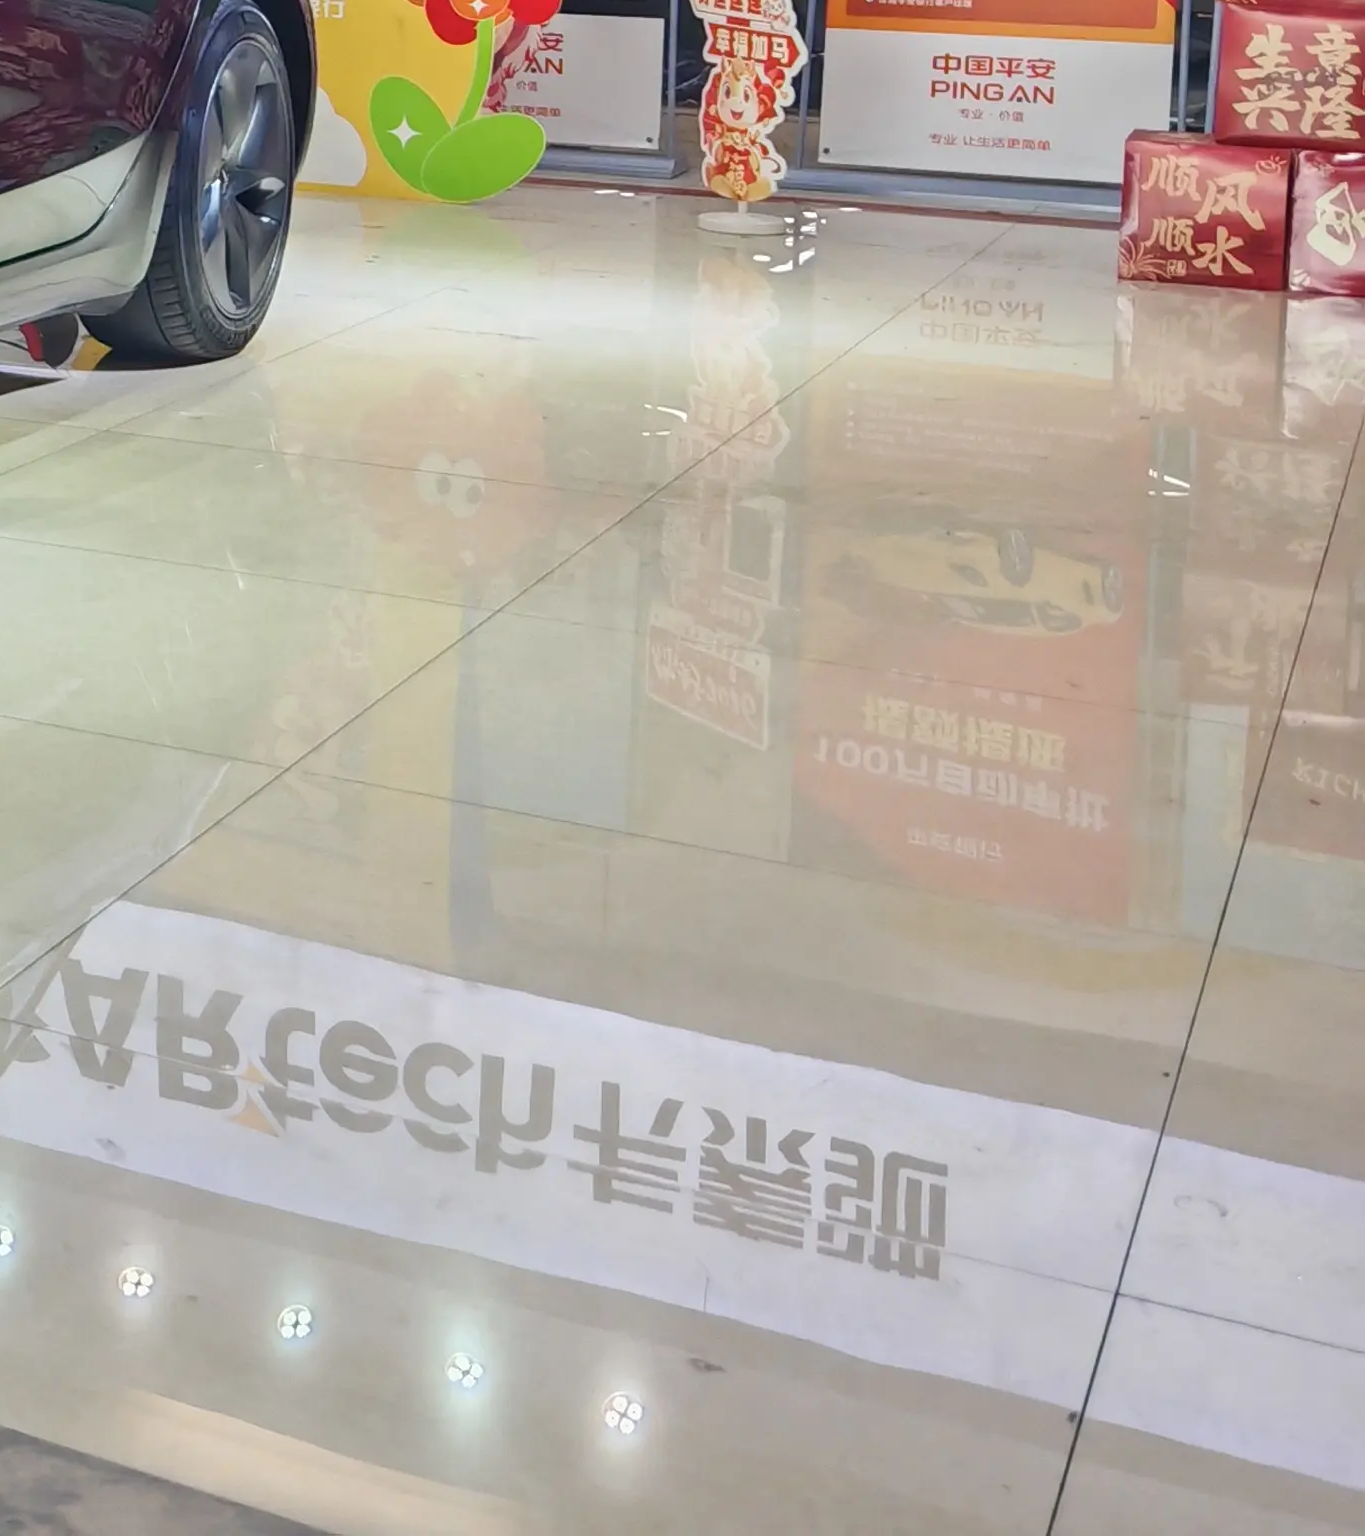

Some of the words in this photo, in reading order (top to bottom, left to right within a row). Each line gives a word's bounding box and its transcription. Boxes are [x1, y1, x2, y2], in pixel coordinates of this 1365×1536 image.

[715, 28, 790, 64] 幸福加马
[931, 52, 1056, 80] 中国平安
[1234, 23, 1362, 86] 生意
[1232, 81, 1365, 139] 兴隆
[1141, 152, 1266, 231] 顺风
[1143, 216, 1255, 277] 顺水
